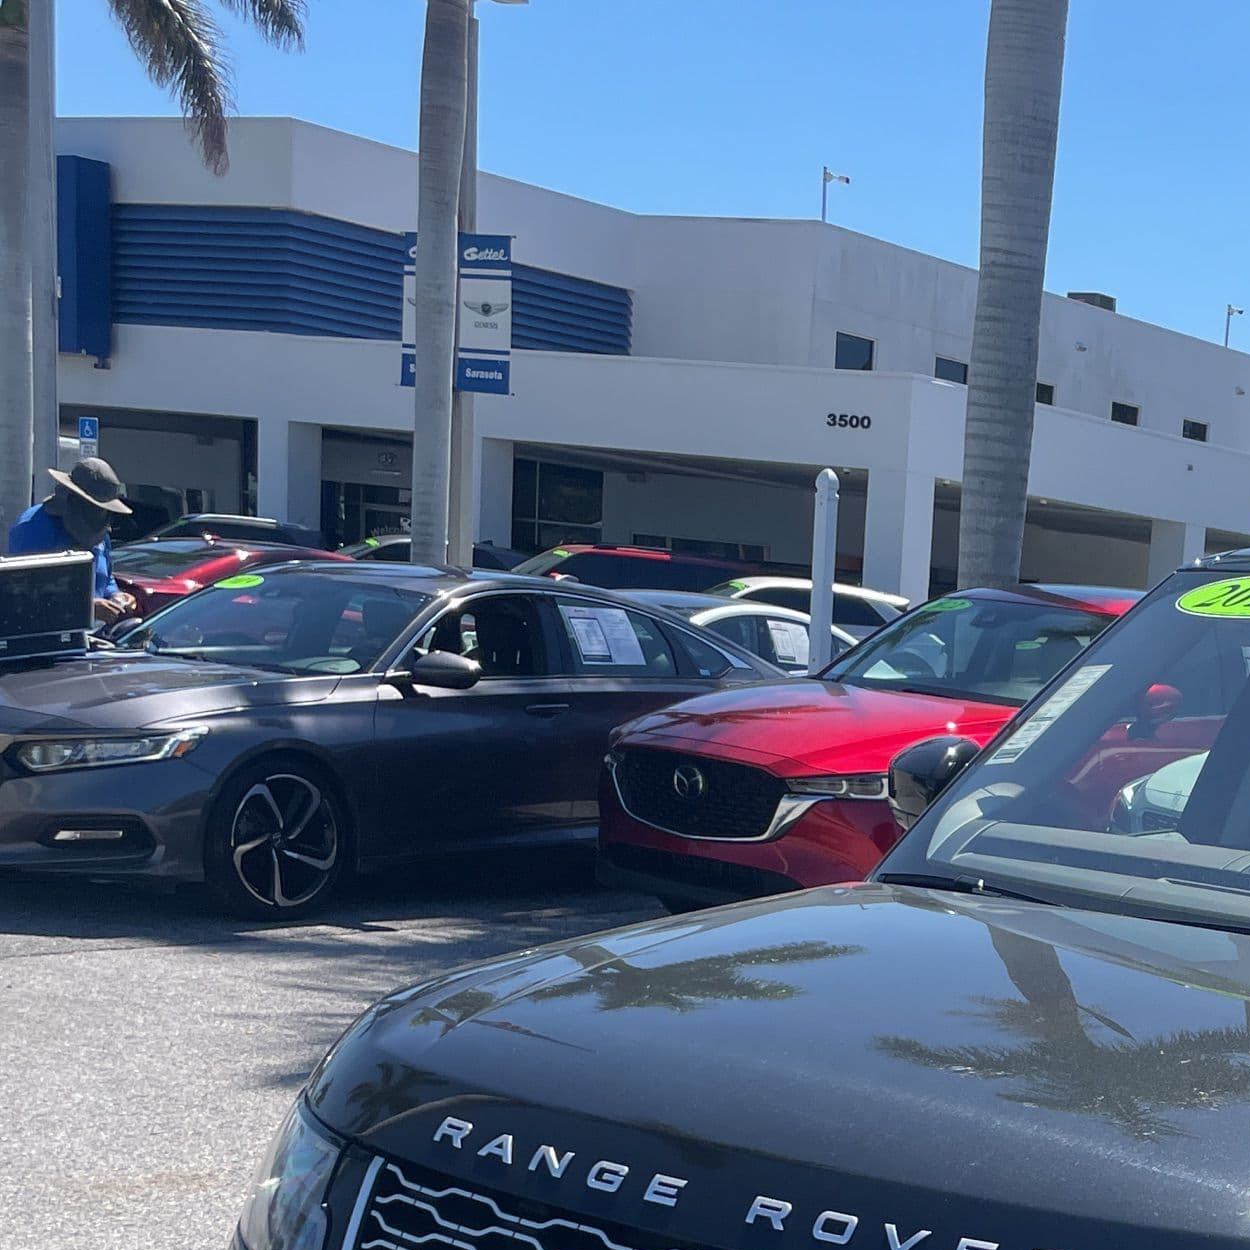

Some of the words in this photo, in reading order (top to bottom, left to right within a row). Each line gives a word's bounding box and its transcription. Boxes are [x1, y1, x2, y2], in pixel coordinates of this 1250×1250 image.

[465, 368, 503, 380] Sarasota
[826, 413, 871, 429] 3500
[432, 1116, 689, 1207] RANGE
